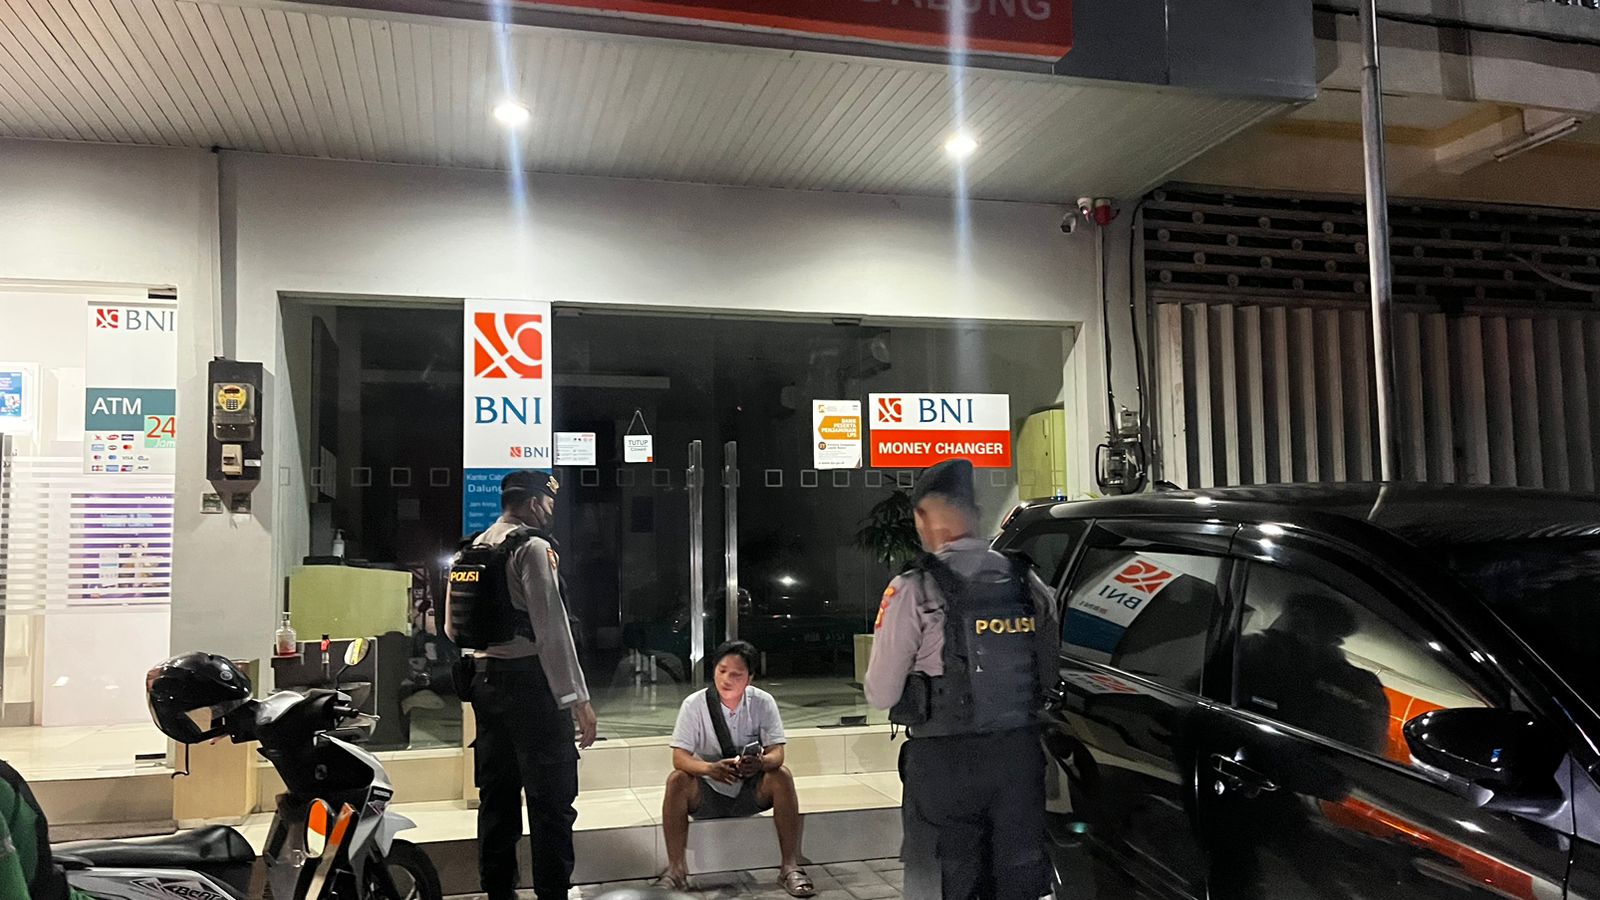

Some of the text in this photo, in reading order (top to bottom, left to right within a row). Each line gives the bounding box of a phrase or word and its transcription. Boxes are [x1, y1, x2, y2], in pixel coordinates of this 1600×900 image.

[126, 309, 175, 331] BNI
[91, 396, 142, 415] ATM
[475, 396, 542, 425] BNI
[918, 398, 974, 424] BNI
[146, 416, 176, 438] 24
[523, 446, 549, 458] BNI
[878, 442, 1004, 455] MONEY CHANGER
[450, 571, 480, 582] POLISI
[975, 616, 1036, 635] POLISI
